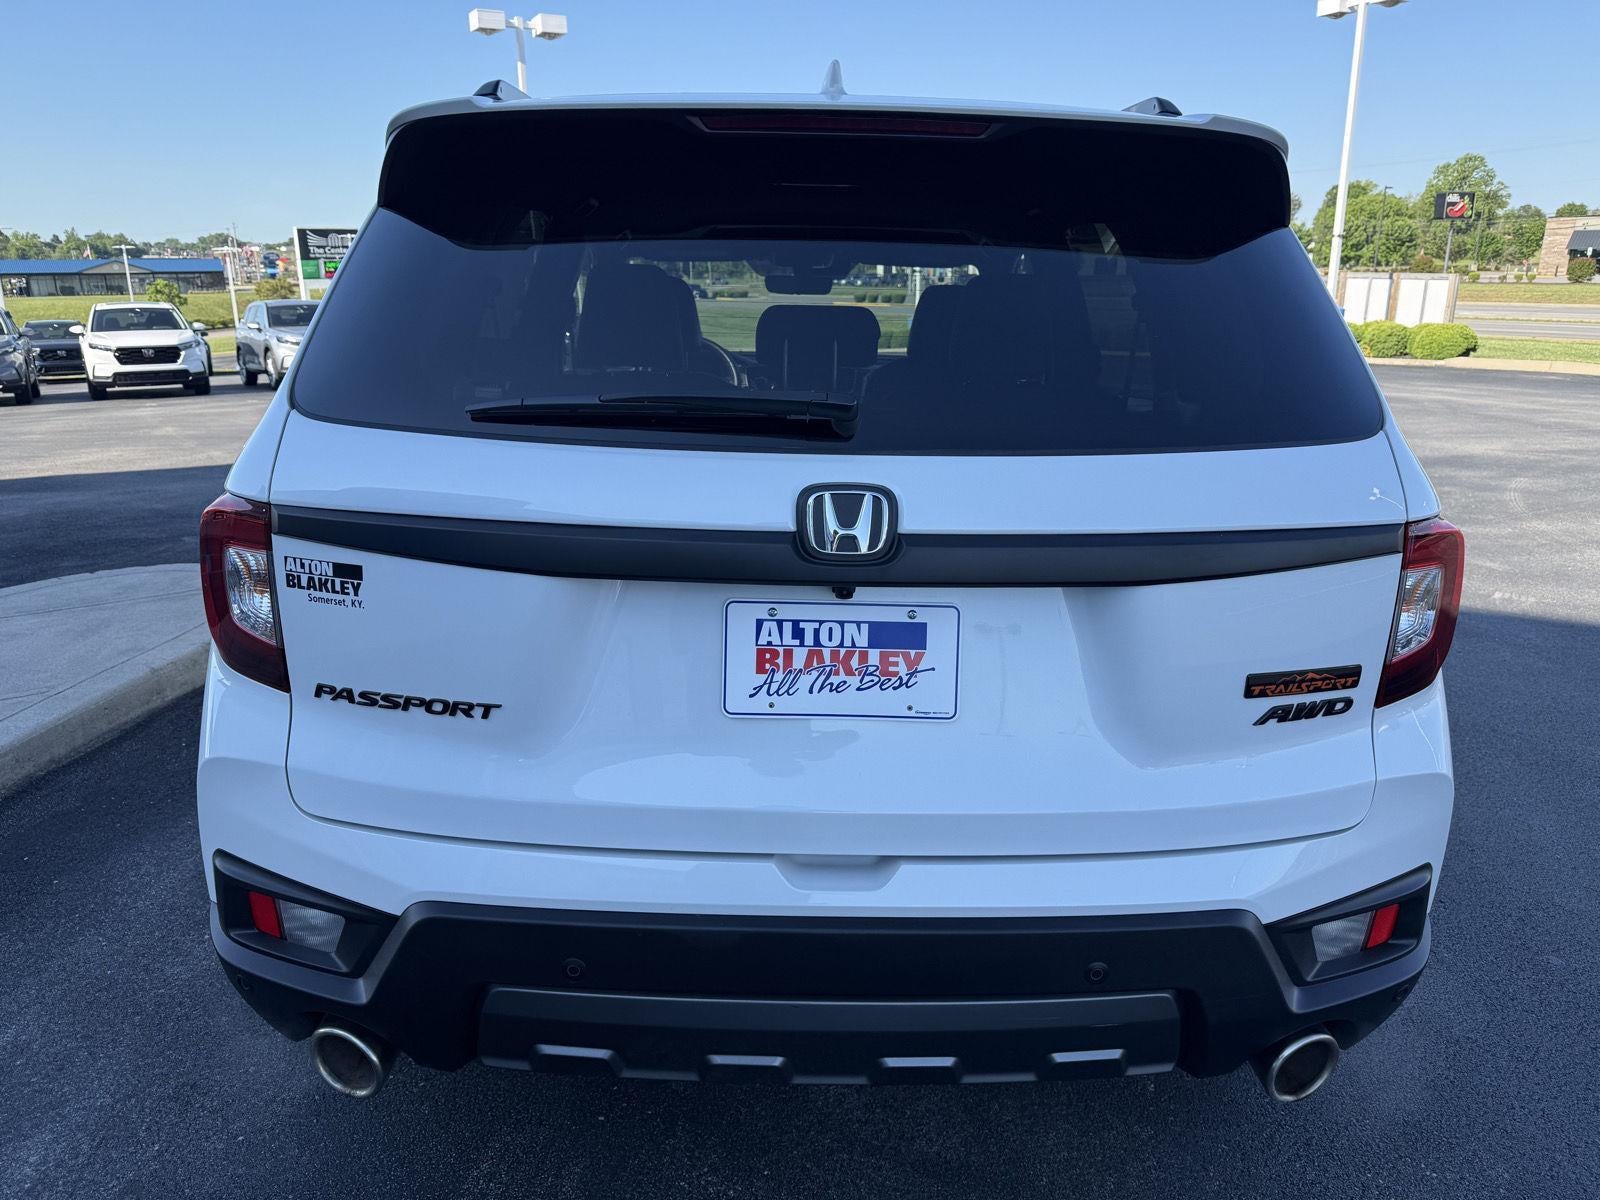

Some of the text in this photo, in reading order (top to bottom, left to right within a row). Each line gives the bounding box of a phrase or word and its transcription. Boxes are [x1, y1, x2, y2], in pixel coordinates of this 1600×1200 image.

[308, 246, 348, 254] The Cente
[285, 556, 334, 577] ALTON
[285, 572, 362, 597] BLAKLEY
[307, 593, 365, 609] Somerset, KY.
[757, 621, 869, 648] ALTON
[755, 647, 926, 678] BLAKLEY
[749, 664, 936, 698] All The Best
[1250, 677, 1359, 697] TRAILSPORT
[313, 682, 503, 720] PASSPORT
[1252, 696, 1354, 726] AWD
